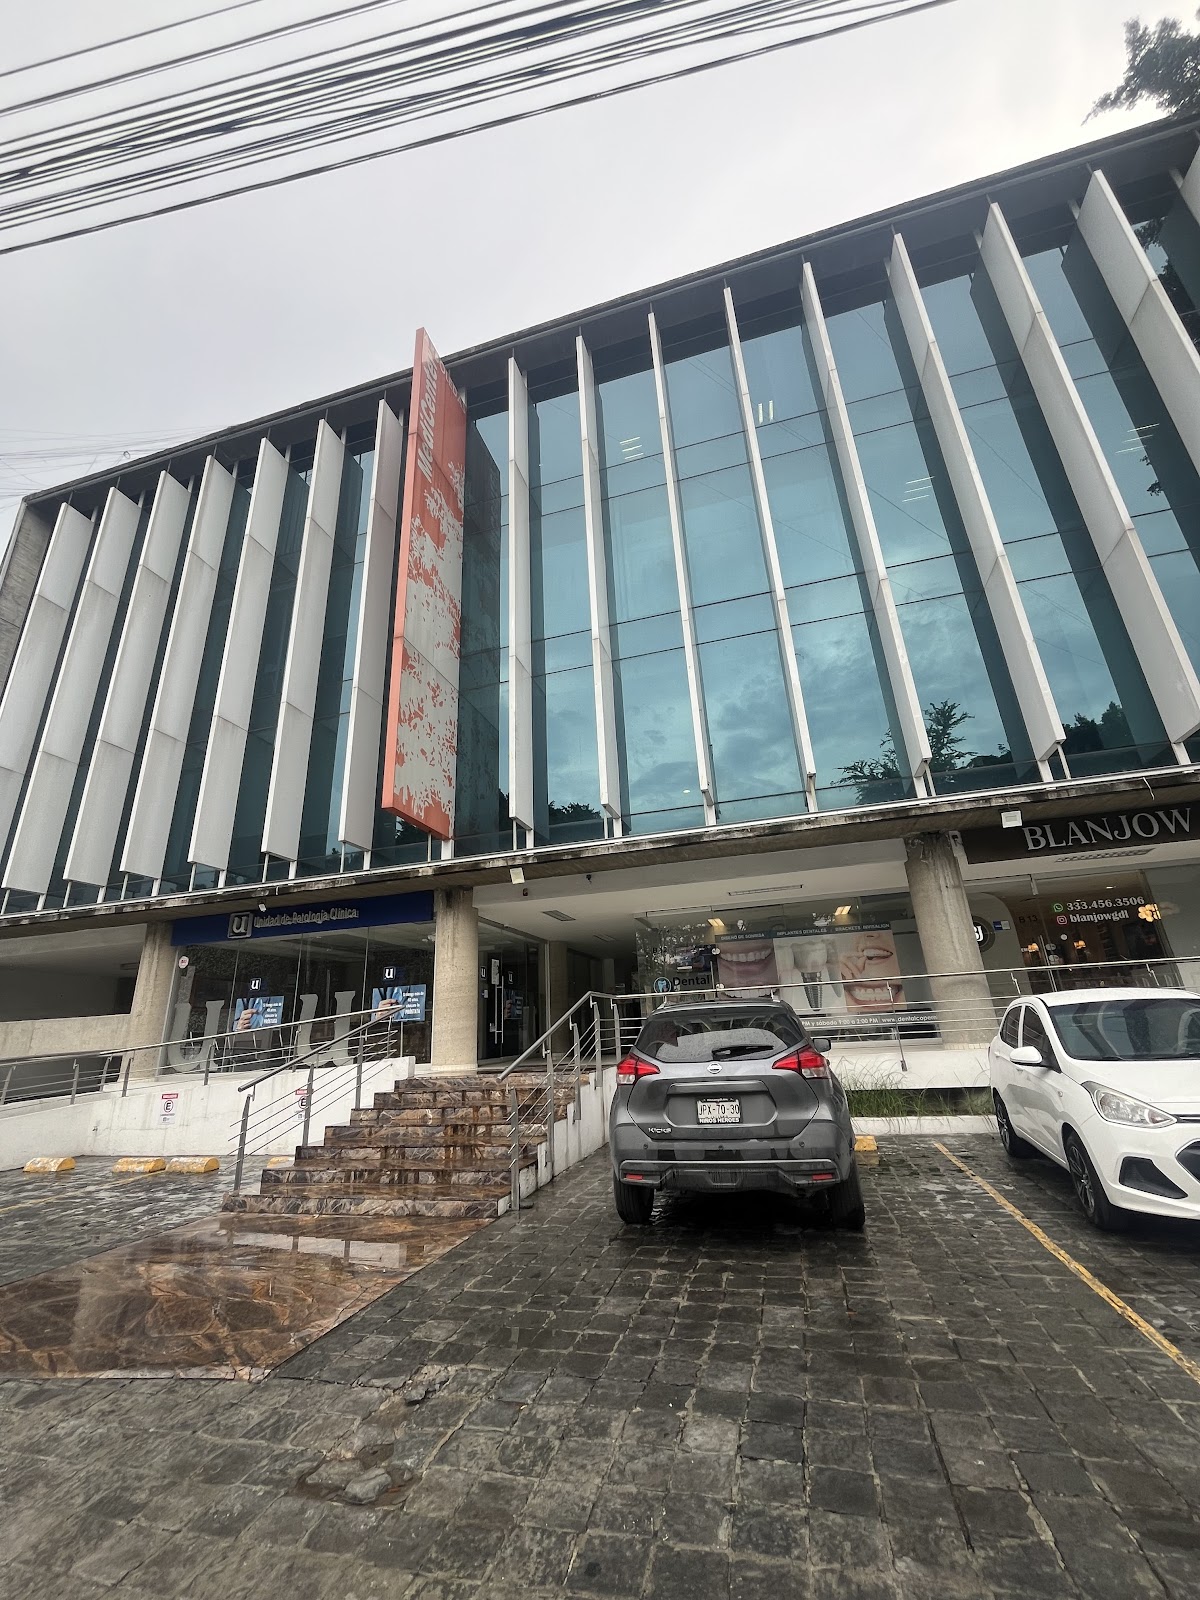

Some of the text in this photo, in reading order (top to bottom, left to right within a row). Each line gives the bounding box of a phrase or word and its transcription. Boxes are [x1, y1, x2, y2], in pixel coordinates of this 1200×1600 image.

[1022, 808, 1191, 851] BLANJOW
[1066, 895, 1145, 911] 333.456.3506
[254, 914, 282, 929] Unidad
[281, 914, 293, 926] de
[1069, 909, 1130, 924] blanjowgdl
[672, 975, 710, 986] Dental
[816, 1018, 838, 1026] sábado
[165, 1102, 171, 1110] E
[698, 1103, 739, 1115] JPX-70-30
